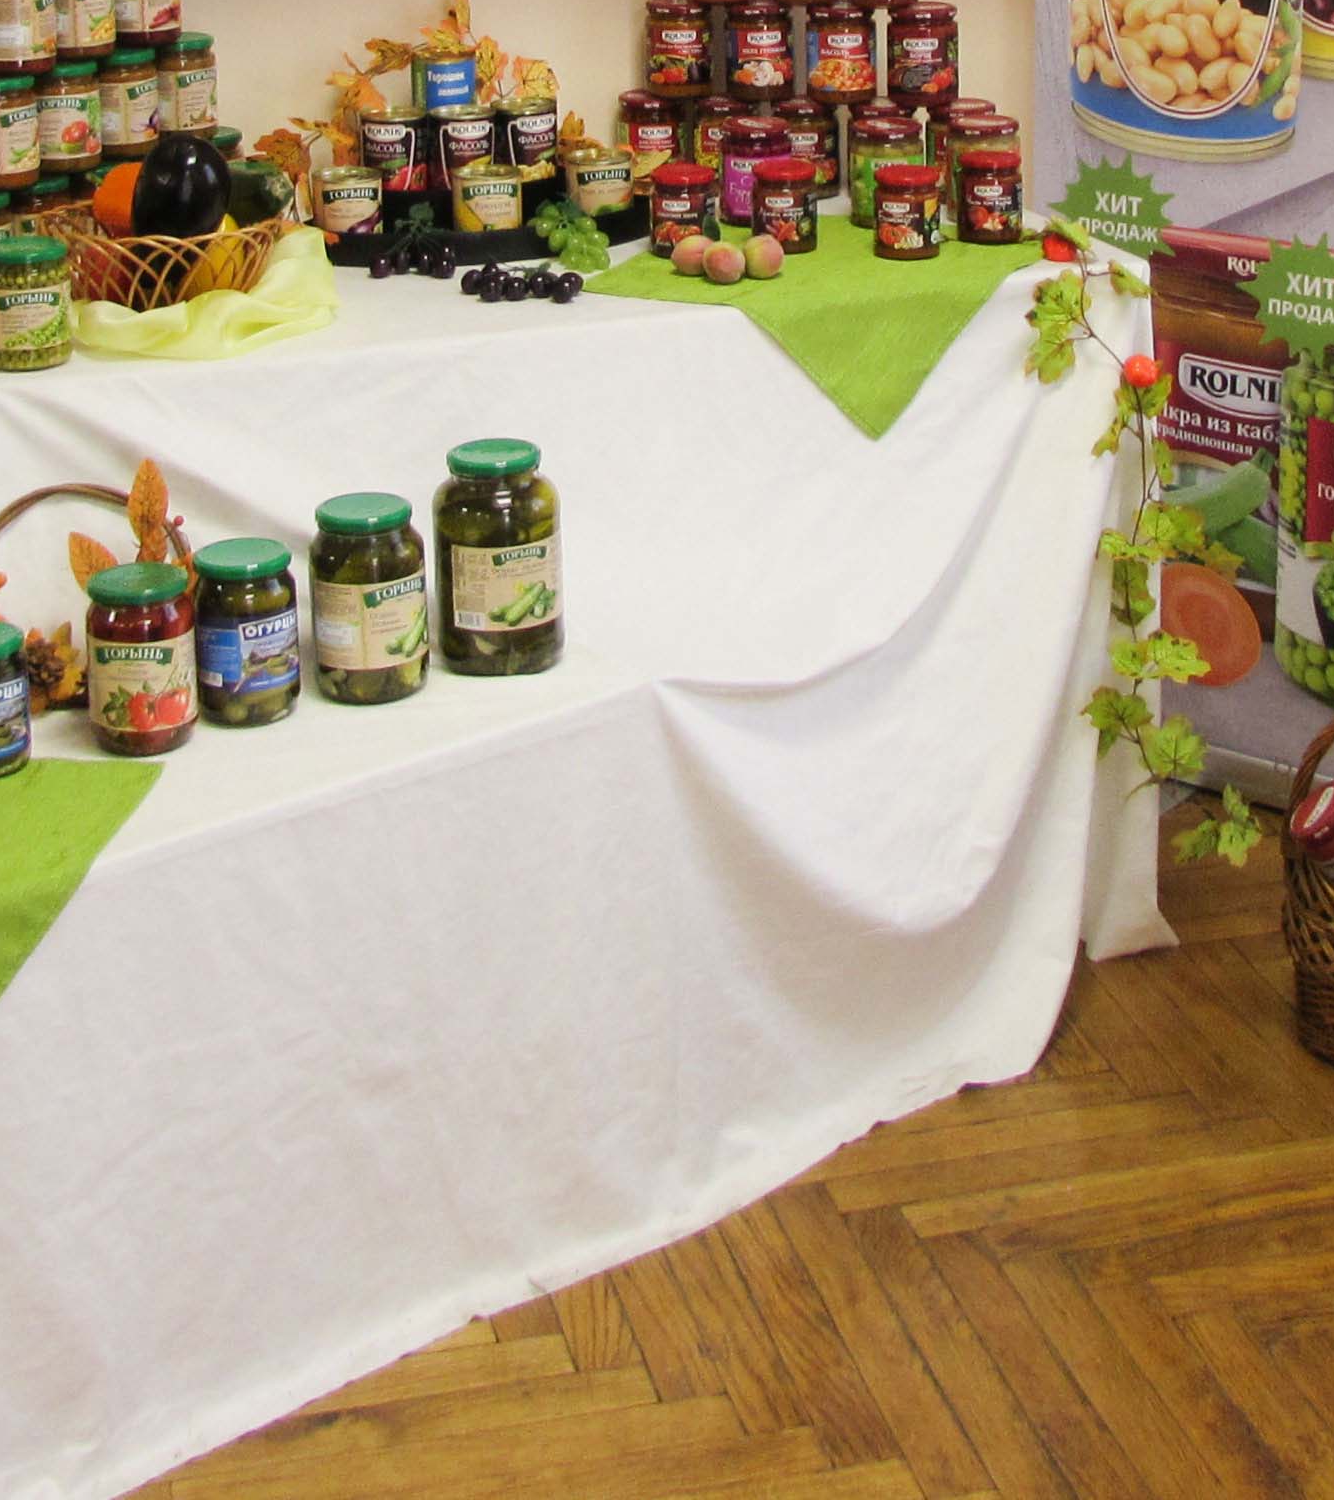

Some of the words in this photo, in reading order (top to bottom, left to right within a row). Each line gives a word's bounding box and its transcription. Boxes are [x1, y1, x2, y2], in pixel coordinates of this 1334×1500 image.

[449, 140, 490, 151] ФАСОЛЬ
[329, 187, 375, 201] ГОРЫНЬ
[469, 184, 514, 197] ГОРЫНЬ
[1094, 191, 1142, 217] ХИТ
[1189, 365, 1281, 403] ROLNI
[1207, 416, 1231, 434] из
[100, 647, 164, 660] ГОРЫНЬ
